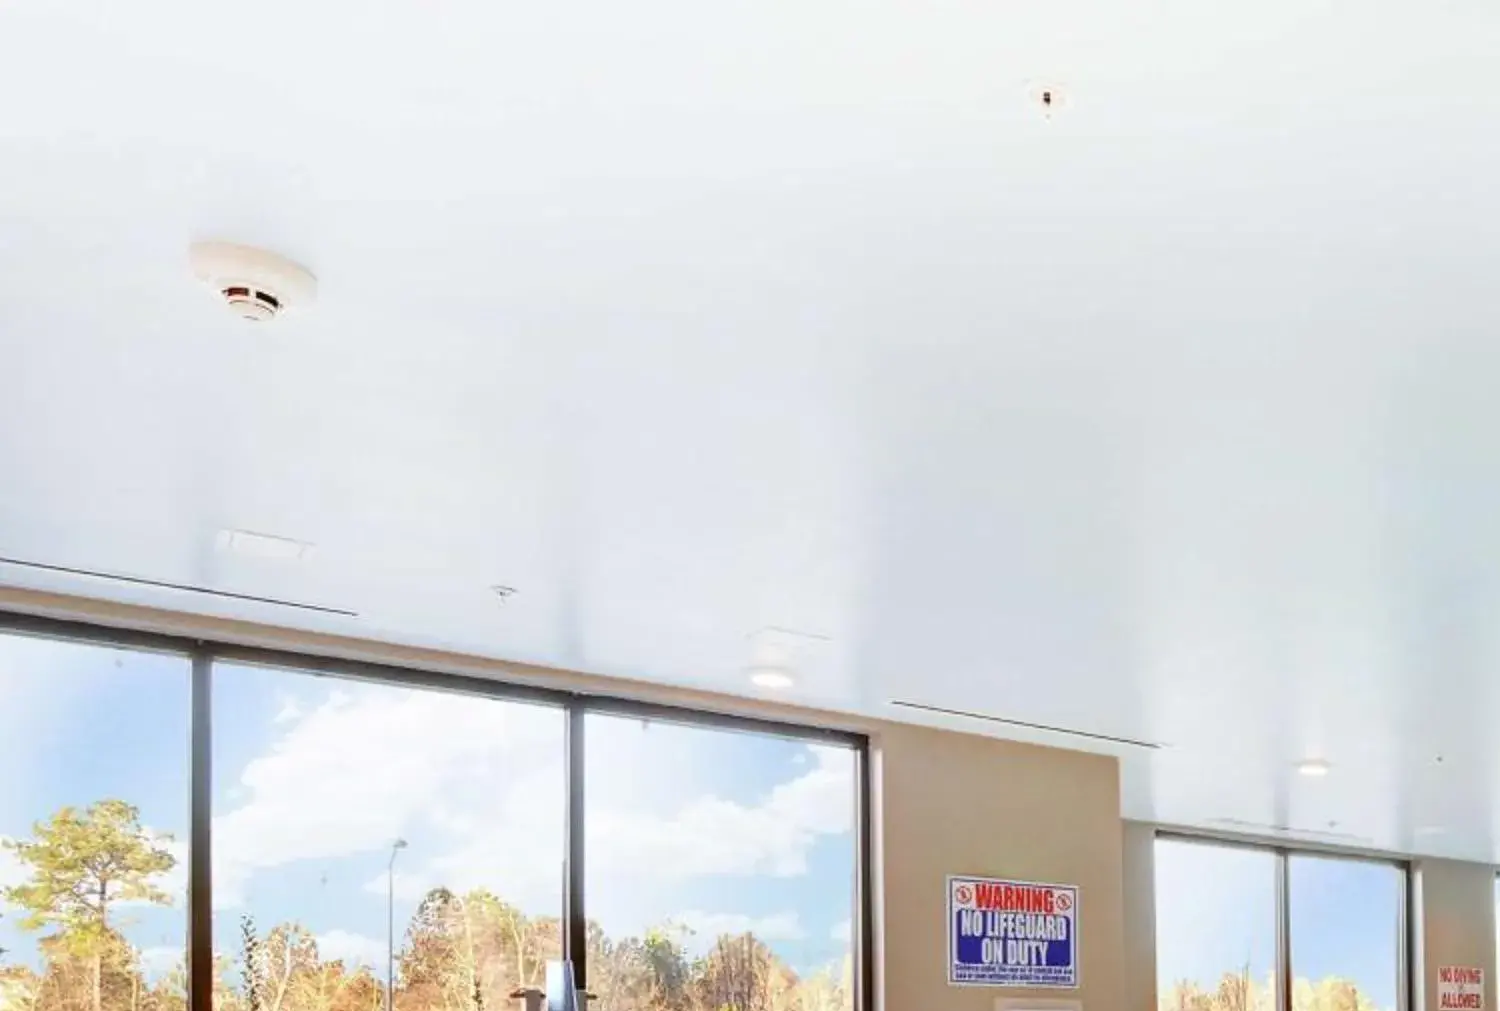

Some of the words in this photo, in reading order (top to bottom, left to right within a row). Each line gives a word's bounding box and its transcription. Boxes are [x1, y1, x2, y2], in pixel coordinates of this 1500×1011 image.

[975, 883, 1055, 914] WARNING
[961, 910, 983, 937] NO
[988, 912, 1067, 941] LIFEGUARD
[981, 938, 1003, 964] ON
[1007, 939, 1049, 966] DUTY
[1440, 967, 1451, 982] NO
[1440, 992, 1480, 1008] ALLOWED
